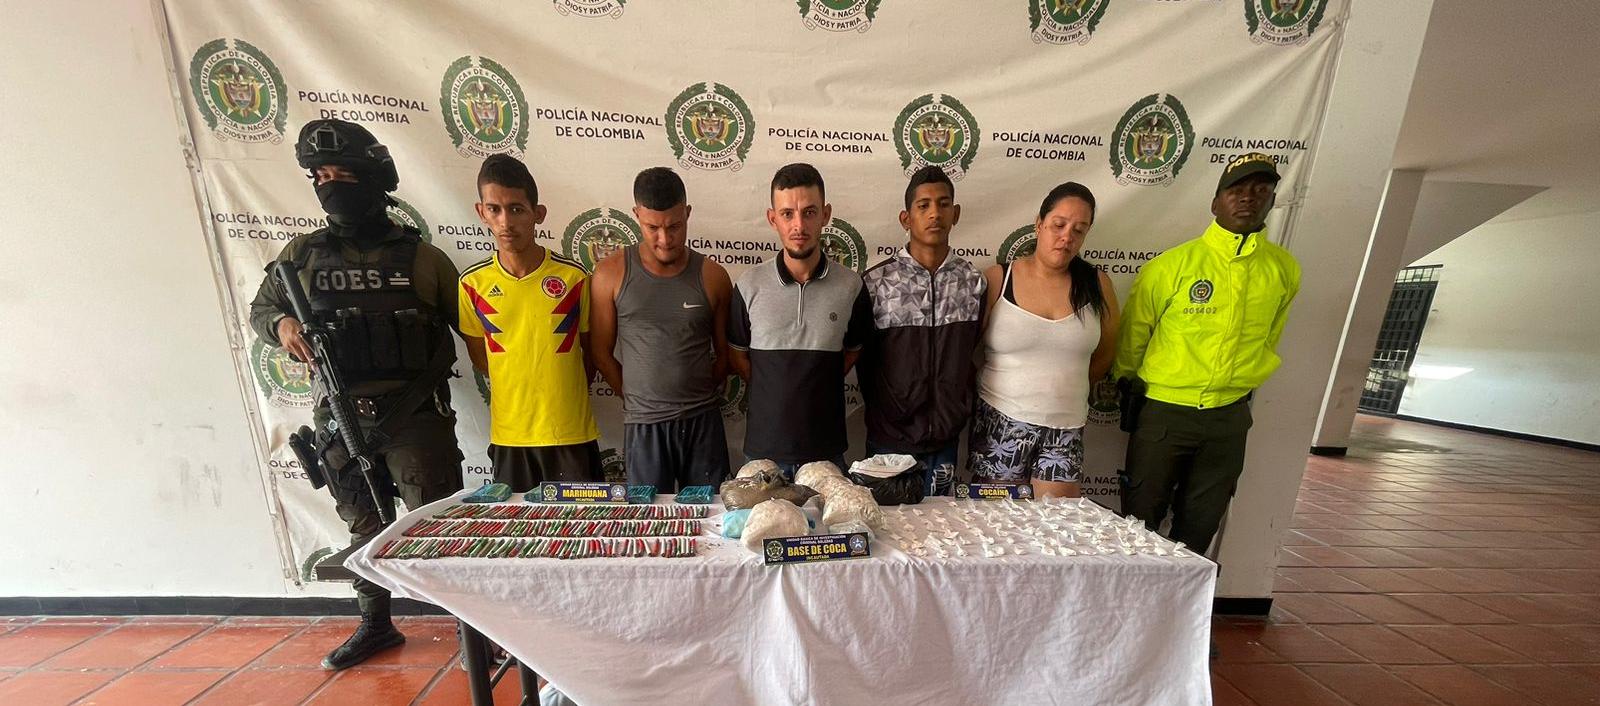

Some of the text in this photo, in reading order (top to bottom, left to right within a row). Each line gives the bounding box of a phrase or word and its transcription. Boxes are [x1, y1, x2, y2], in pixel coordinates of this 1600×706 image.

[590, 2, 613, 14] PATRIA
[814, 14, 830, 28] DIOS
[837, 17, 861, 28] PATRIA
[1041, 4, 1096, 32] POLICIA NACIONAL
[1257, 10, 1314, 33] POLICIA NACIONAL
[1041, 28, 1054, 40] DIOS
[1060, 31, 1082, 42] PATRIA
[1260, 31, 1275, 41] DIOS
[1282, 32, 1303, 42] PATRIA
[202, 50, 276, 99] REPUBLICA DE COLOMBIA
[298, 90, 429, 112] POLICÍA NACIONAL
[452, 72, 468, 115] REPUBLICA
[491, 74, 518, 118] COLOMBIA
[210, 105, 276, 131] POLICIA NACIONAL
[320, 109, 410, 124] DE COLOMBIA
[536, 108, 662, 126] POLICÍA NACIONAL
[677, 97, 700, 127] REPUBLICA
[724, 99, 744, 133] COLOMBIA
[904, 108, 926, 140] REPUBLICA
[948, 109, 970, 140] COLOMBIA
[1120, 108, 1149, 147] REPUBLICA
[1167, 110, 1184, 146] COLOMBIA
[223, 127, 241, 139] DIOS
[249, 130, 273, 141] PATRIA
[458, 125, 518, 150] POLICIA NACIONAL
[556, 126, 645, 140] DE COLOMBIA
[768, 128, 889, 142] POLICÍA NACIONAL
[993, 131, 1104, 146] POLICÍA NACIONAL
[681, 135, 741, 158] POLICIA NACIONAL
[786, 142, 872, 153] DE COLOMBIA
[1202, 136, 1308, 150] POLICÍA NACIONAL
[467, 146, 484, 157] DIOS
[908, 147, 929, 167] POLICIA
[1006, 148, 1086, 161] DE COLOMBIA
[688, 156, 704, 167] DIOS
[711, 158, 734, 168] PATRIA
[1120, 154, 1179, 175] POLICIA NACIONAL
[1210, 154, 1225, 164] DE
[1126, 174, 1143, 183] DIOS
[1147, 174, 1168, 184] PATRIA
[264, 215, 328, 229] NACIONA
[228, 229, 245, 238] DE
[438, 224, 485, 236] POLICÍA
[574, 221, 595, 254] REPUBLICA
[457, 241, 472, 250] DE
[716, 241, 780, 252] NACIONAL
[840, 232, 857, 268] COLOMBIA
[1084, 249, 1125, 260] POLICÍA
[316, 269, 382, 290] GOES
[268, 379, 291, 397] POLICIA
[277, 396, 294, 405] DIOS
[283, 471, 298, 479] DE
[563, 490, 607, 498] MARIHUANA
[788, 543, 847, 556] BASE DE COCA
